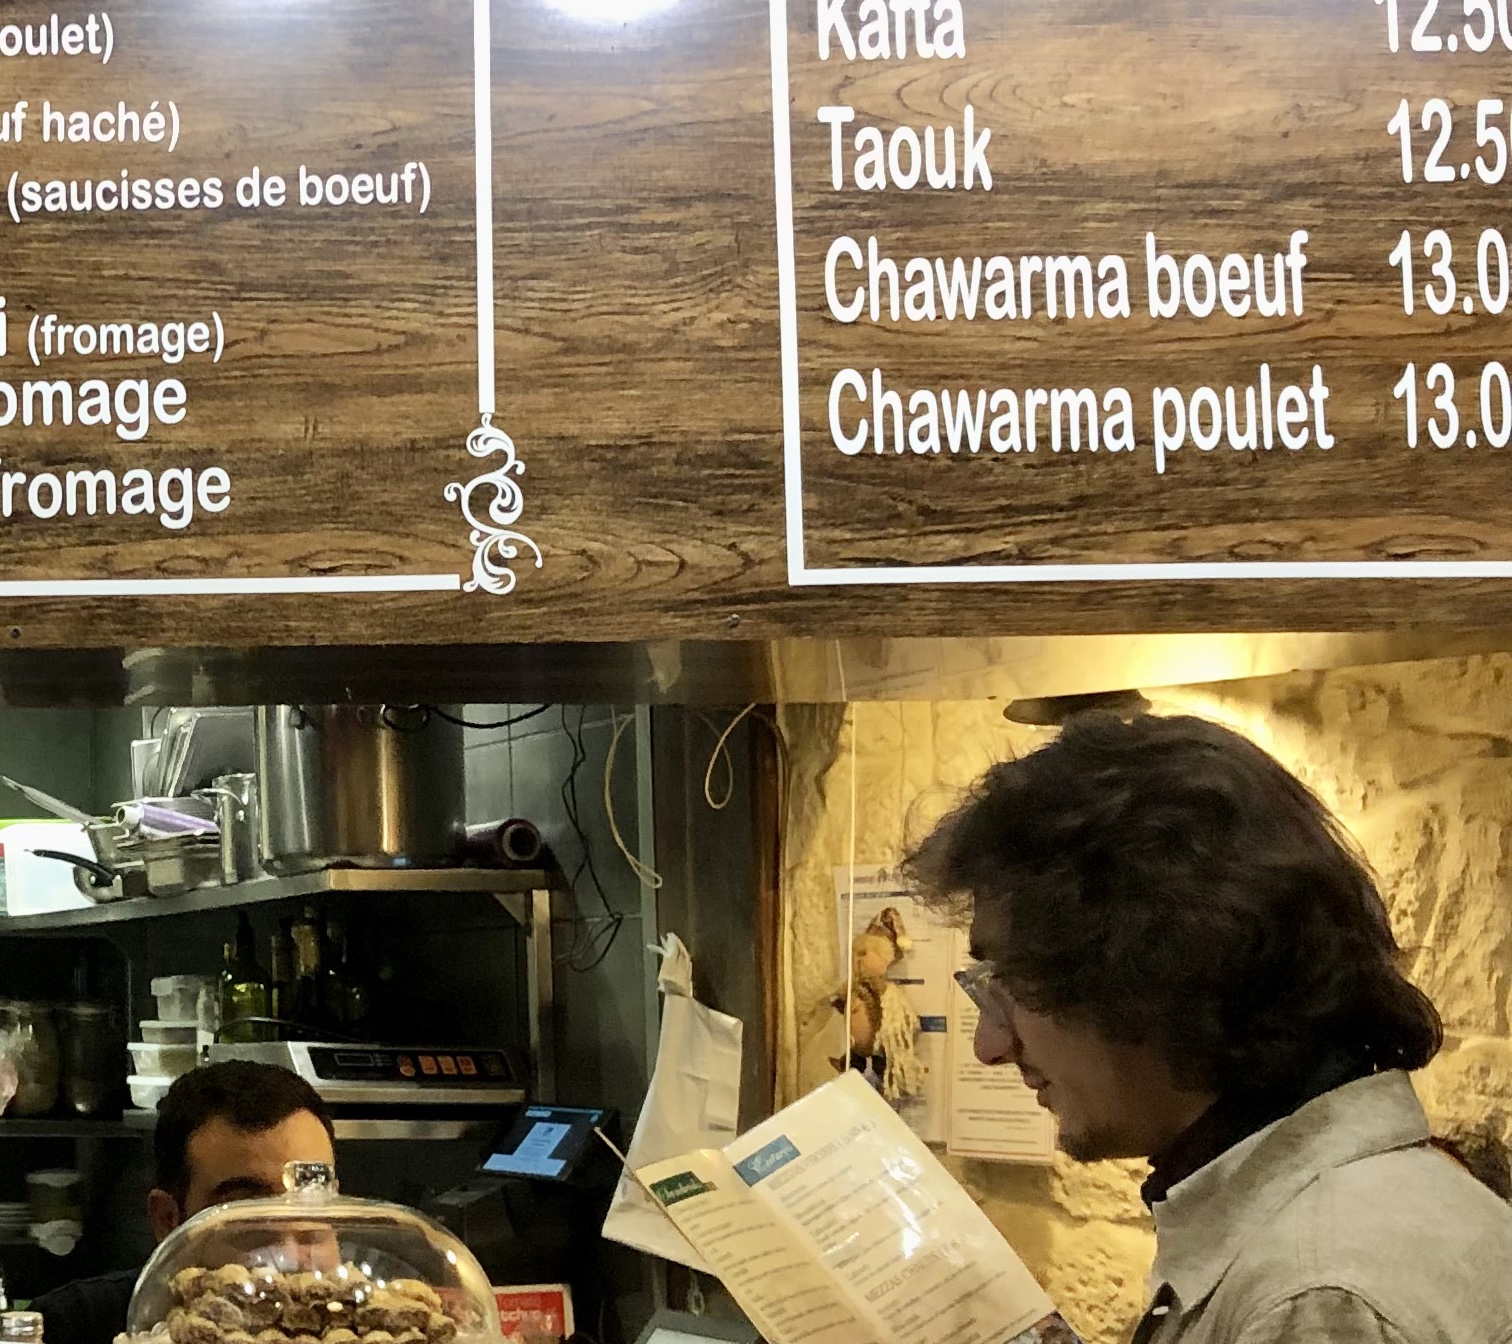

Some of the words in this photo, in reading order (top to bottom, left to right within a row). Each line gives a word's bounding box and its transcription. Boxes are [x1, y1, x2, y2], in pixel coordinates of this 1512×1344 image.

[44, 101, 179, 152] haché)
[818, 105, 992, 190] Taouk
[1387, 98, 1512, 184] 12.5
[8, 169, 223, 222] (saucisses
[237, 167, 285, 207] de
[300, 162, 430, 213] boeuf)
[825, 236, 1130, 322] Chawarma
[1146, 230, 1308, 317] boeuf
[29, 312, 224, 365] (fromage)
[829, 368, 1134, 455] Chawarma
[1153, 363, 1334, 473] poulet
